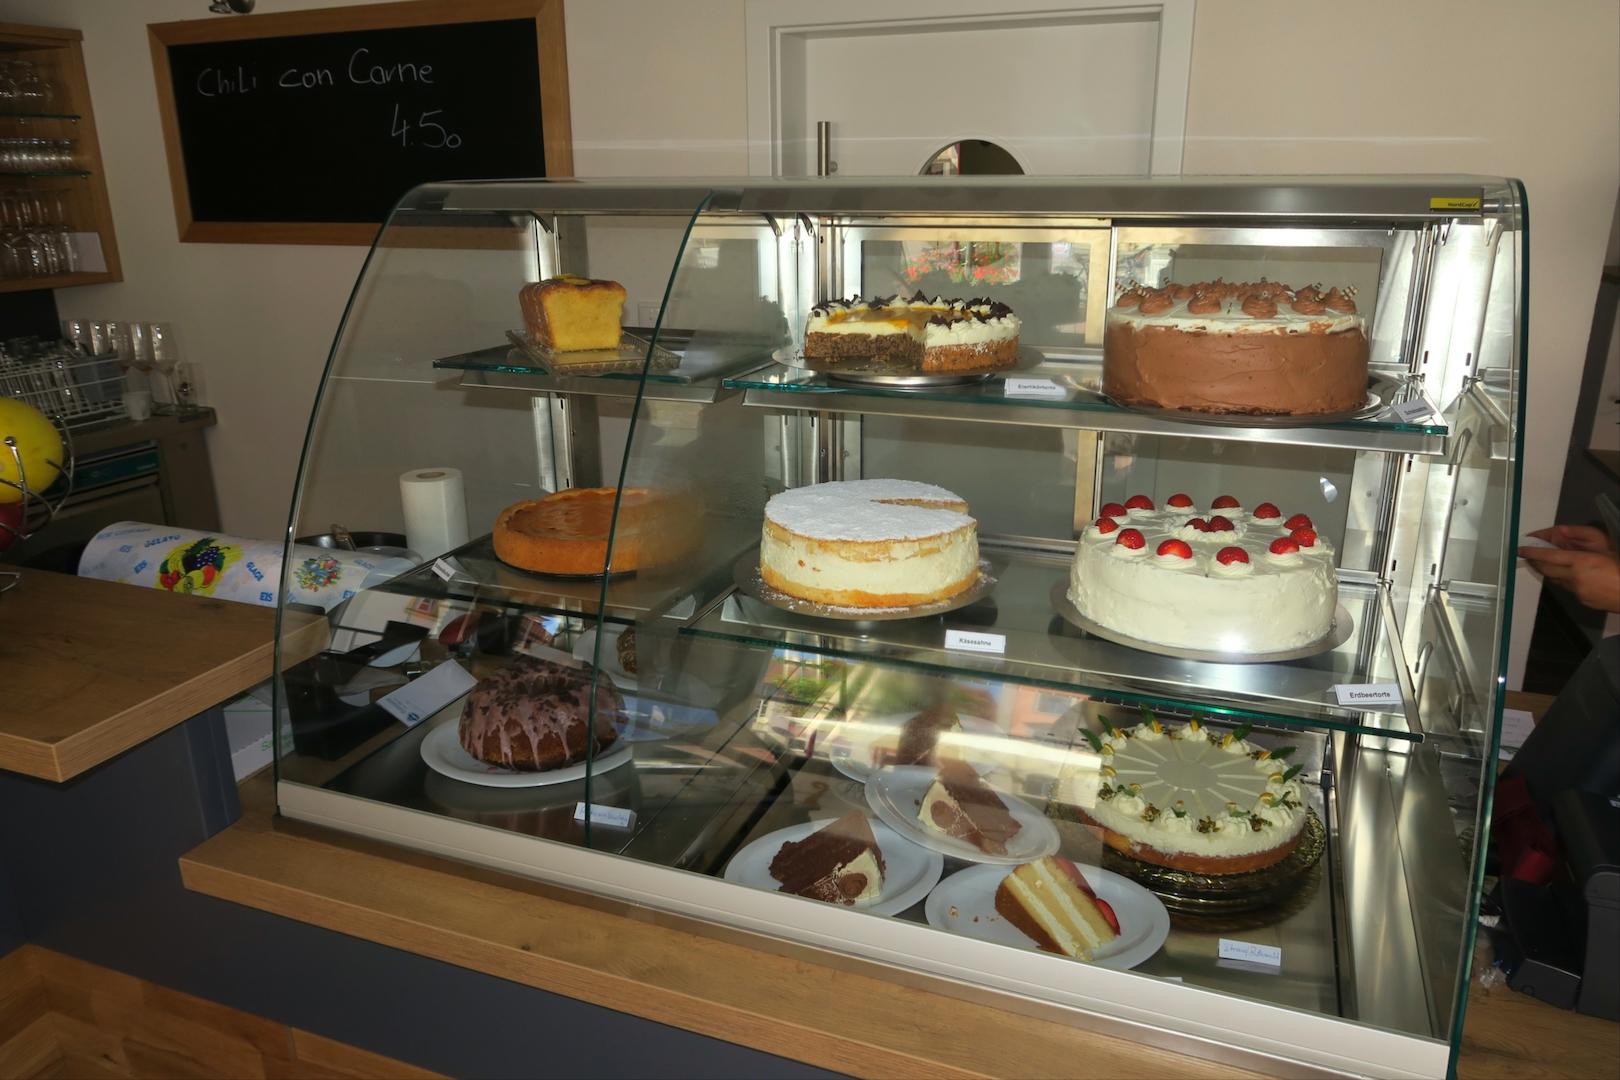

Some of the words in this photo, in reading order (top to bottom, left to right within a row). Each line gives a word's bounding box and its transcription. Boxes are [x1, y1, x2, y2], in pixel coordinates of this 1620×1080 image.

[278, 68, 334, 88] con
[349, 48, 435, 85] Carne
[1349, 691, 1391, 699] Erdbeertorte
